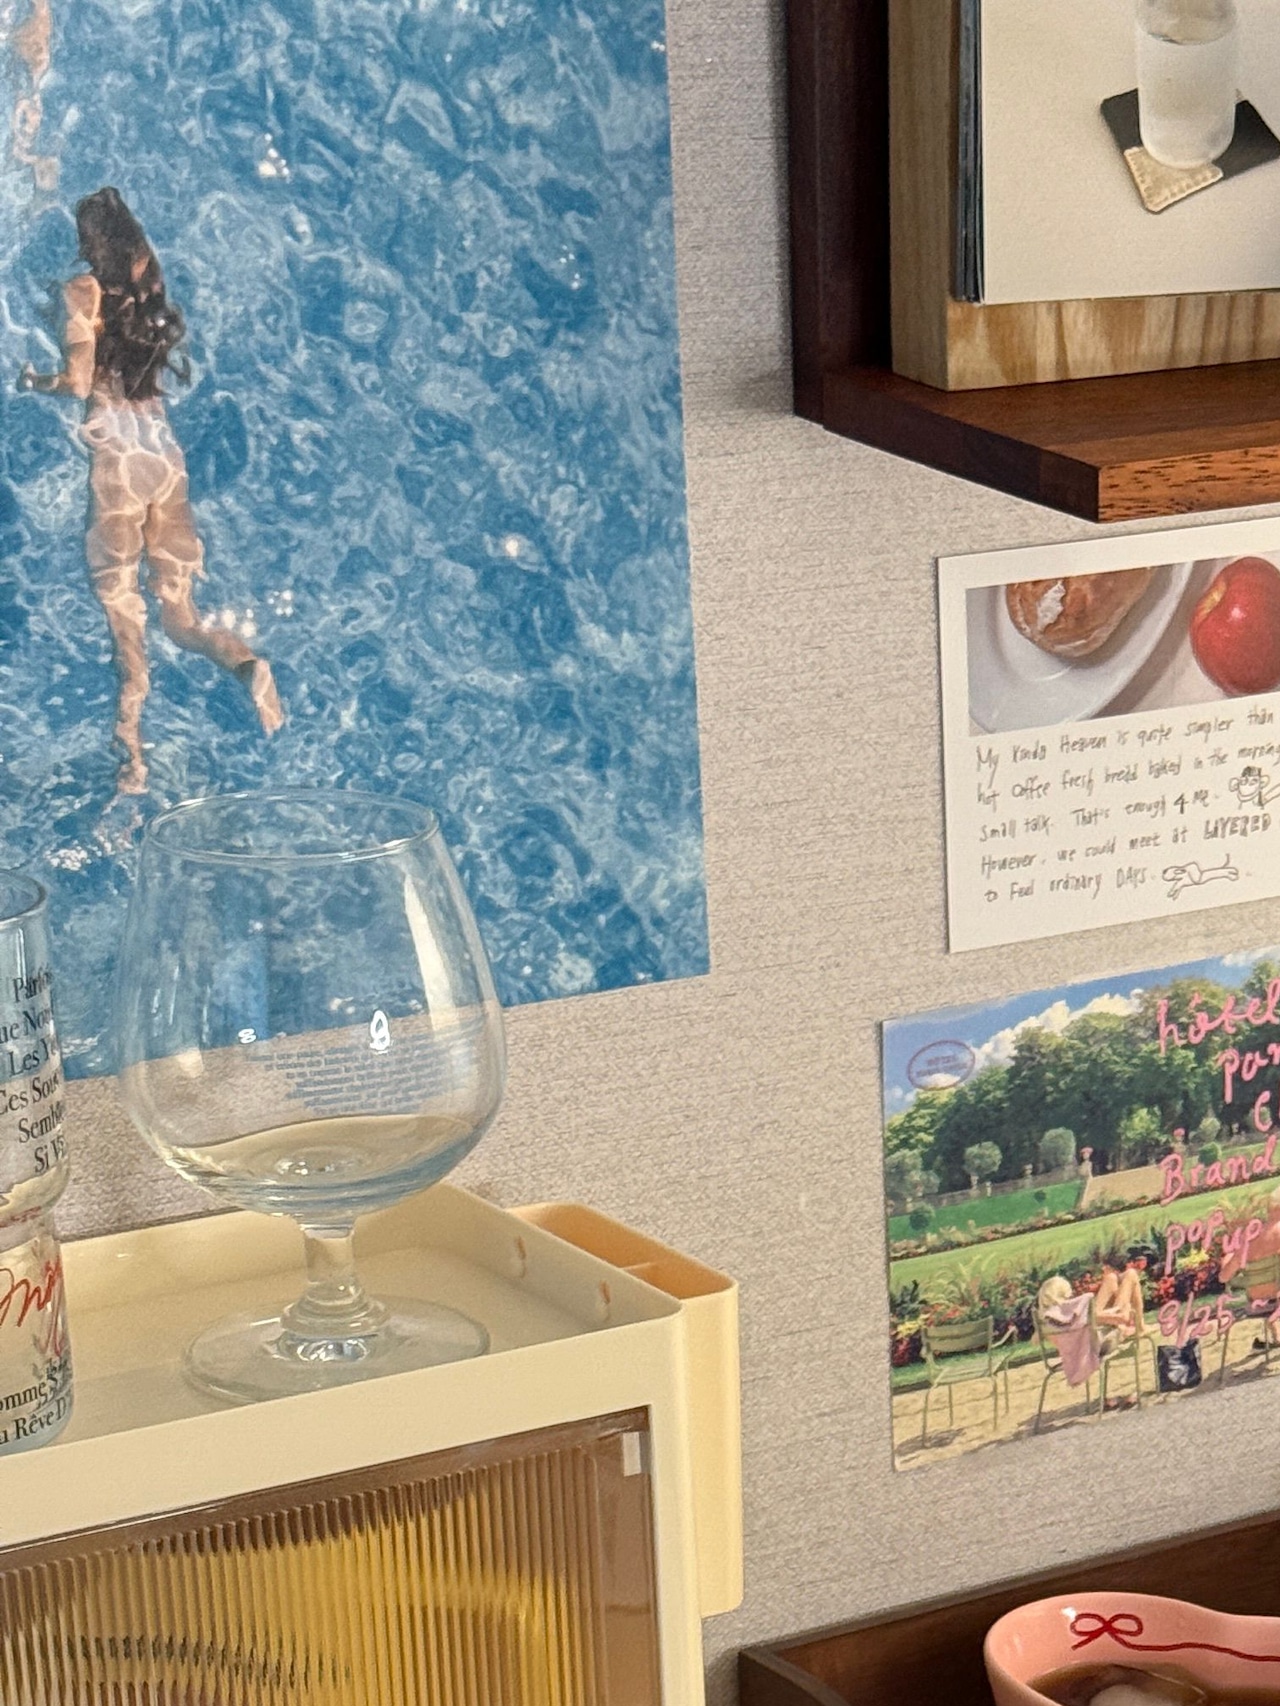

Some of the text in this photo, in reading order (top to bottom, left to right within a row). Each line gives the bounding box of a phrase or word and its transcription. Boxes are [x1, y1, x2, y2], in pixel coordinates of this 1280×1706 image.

[976, 745, 999, 789] My
[1059, 734, 1106, 754] Heaven
[1137, 724, 1173, 747] quite
[977, 783, 999, 813] hot
[1124, 795, 1166, 819] enough
[1173, 793, 1189, 814] 4
[1057, 849, 1074, 862] we
[1085, 836, 1116, 858] could
[1129, 834, 1161, 849] meet
[1172, 828, 1188, 844] at
[1203, 813, 1272, 840] LAYERED
[1050, 875, 1102, 900] ordinary
[0, 1022, 20, 1044] ue
[1160, 1134, 1277, 1207] Brand
[1166, 1208, 1225, 1276] pop
[1222, 1217, 1264, 1269] up
[0, 1380, 47, 1411] omme
[15, 1410, 54, 1440] Rêve
